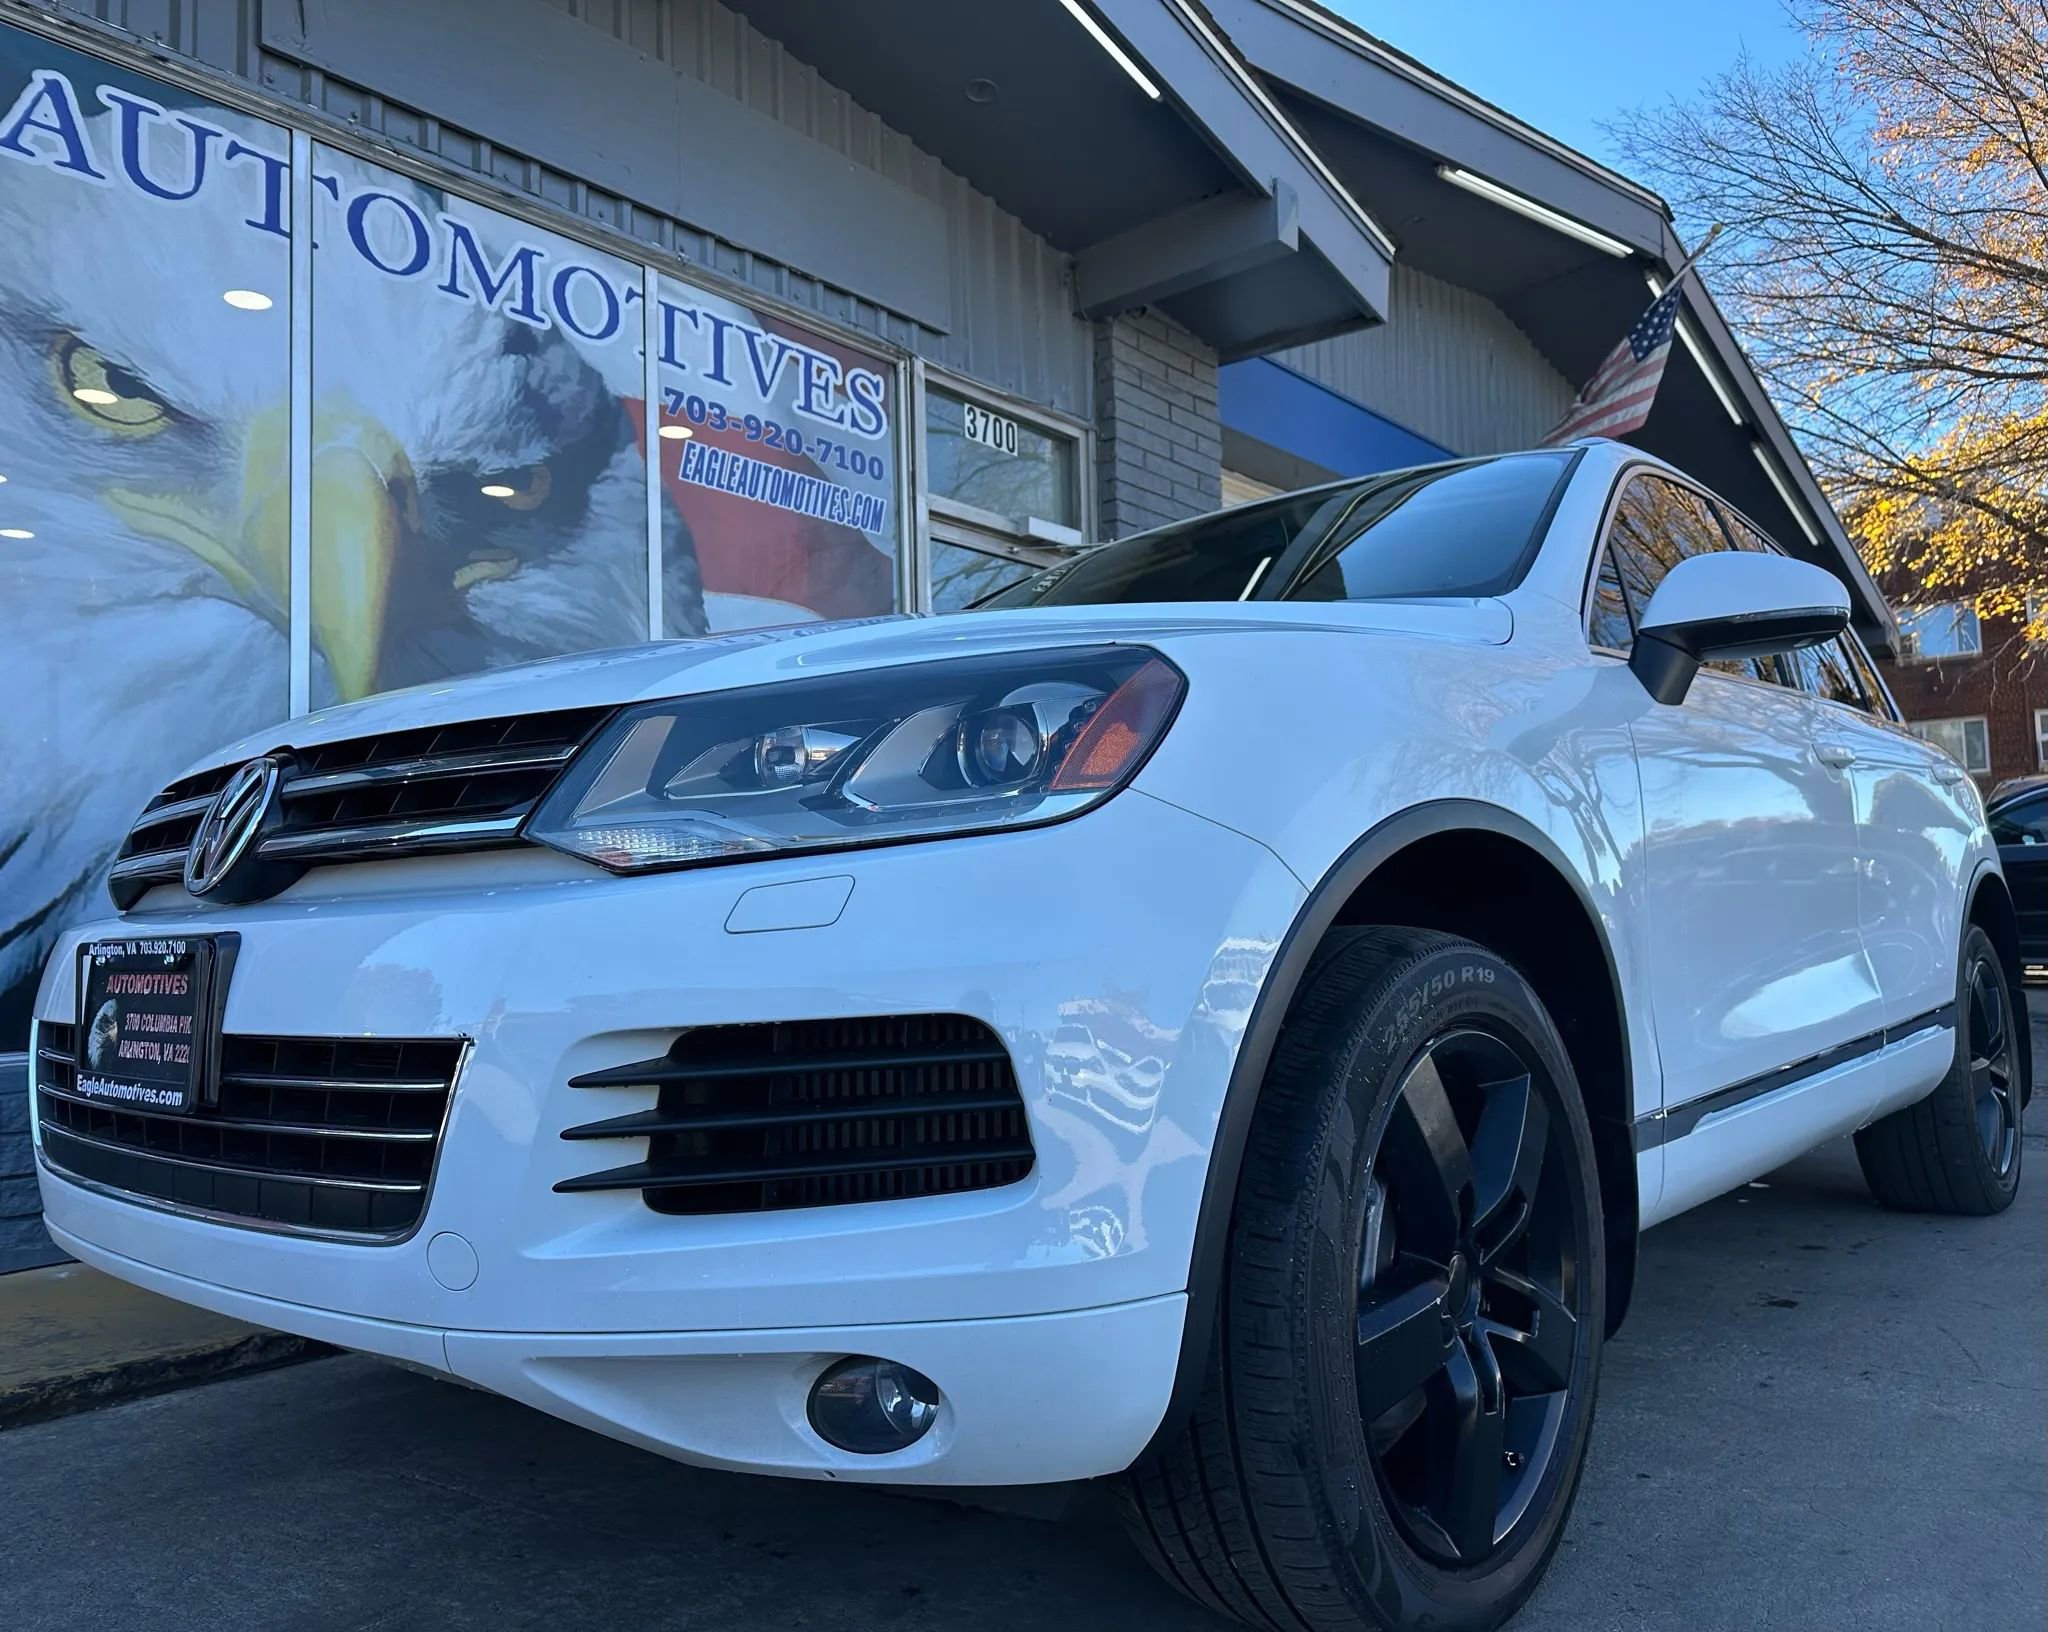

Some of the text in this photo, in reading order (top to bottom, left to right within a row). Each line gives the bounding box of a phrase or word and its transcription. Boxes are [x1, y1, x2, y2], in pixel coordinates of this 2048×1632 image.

[0, 73, 887, 437] AUTOMOTIVES
[663, 386, 885, 481] 703-920-7100
[966, 405, 1016, 454] 3700
[679, 440, 886, 533] EAGLEAUTOMOTIVES.COM
[88, 940, 186, 958] Arlington, VA 703.920.7100
[105, 974, 188, 995] AUTOMOTIVES
[1461, 965, 1496, 984] R19
[140, 1013, 178, 1033] COLUMBIA
[178, 1015, 193, 1034] PIK
[118, 1039, 161, 1065] ARLINGTON,
[163, 1043, 174, 1062] VA
[76, 1073, 183, 1107] EagleAutomotives.com
